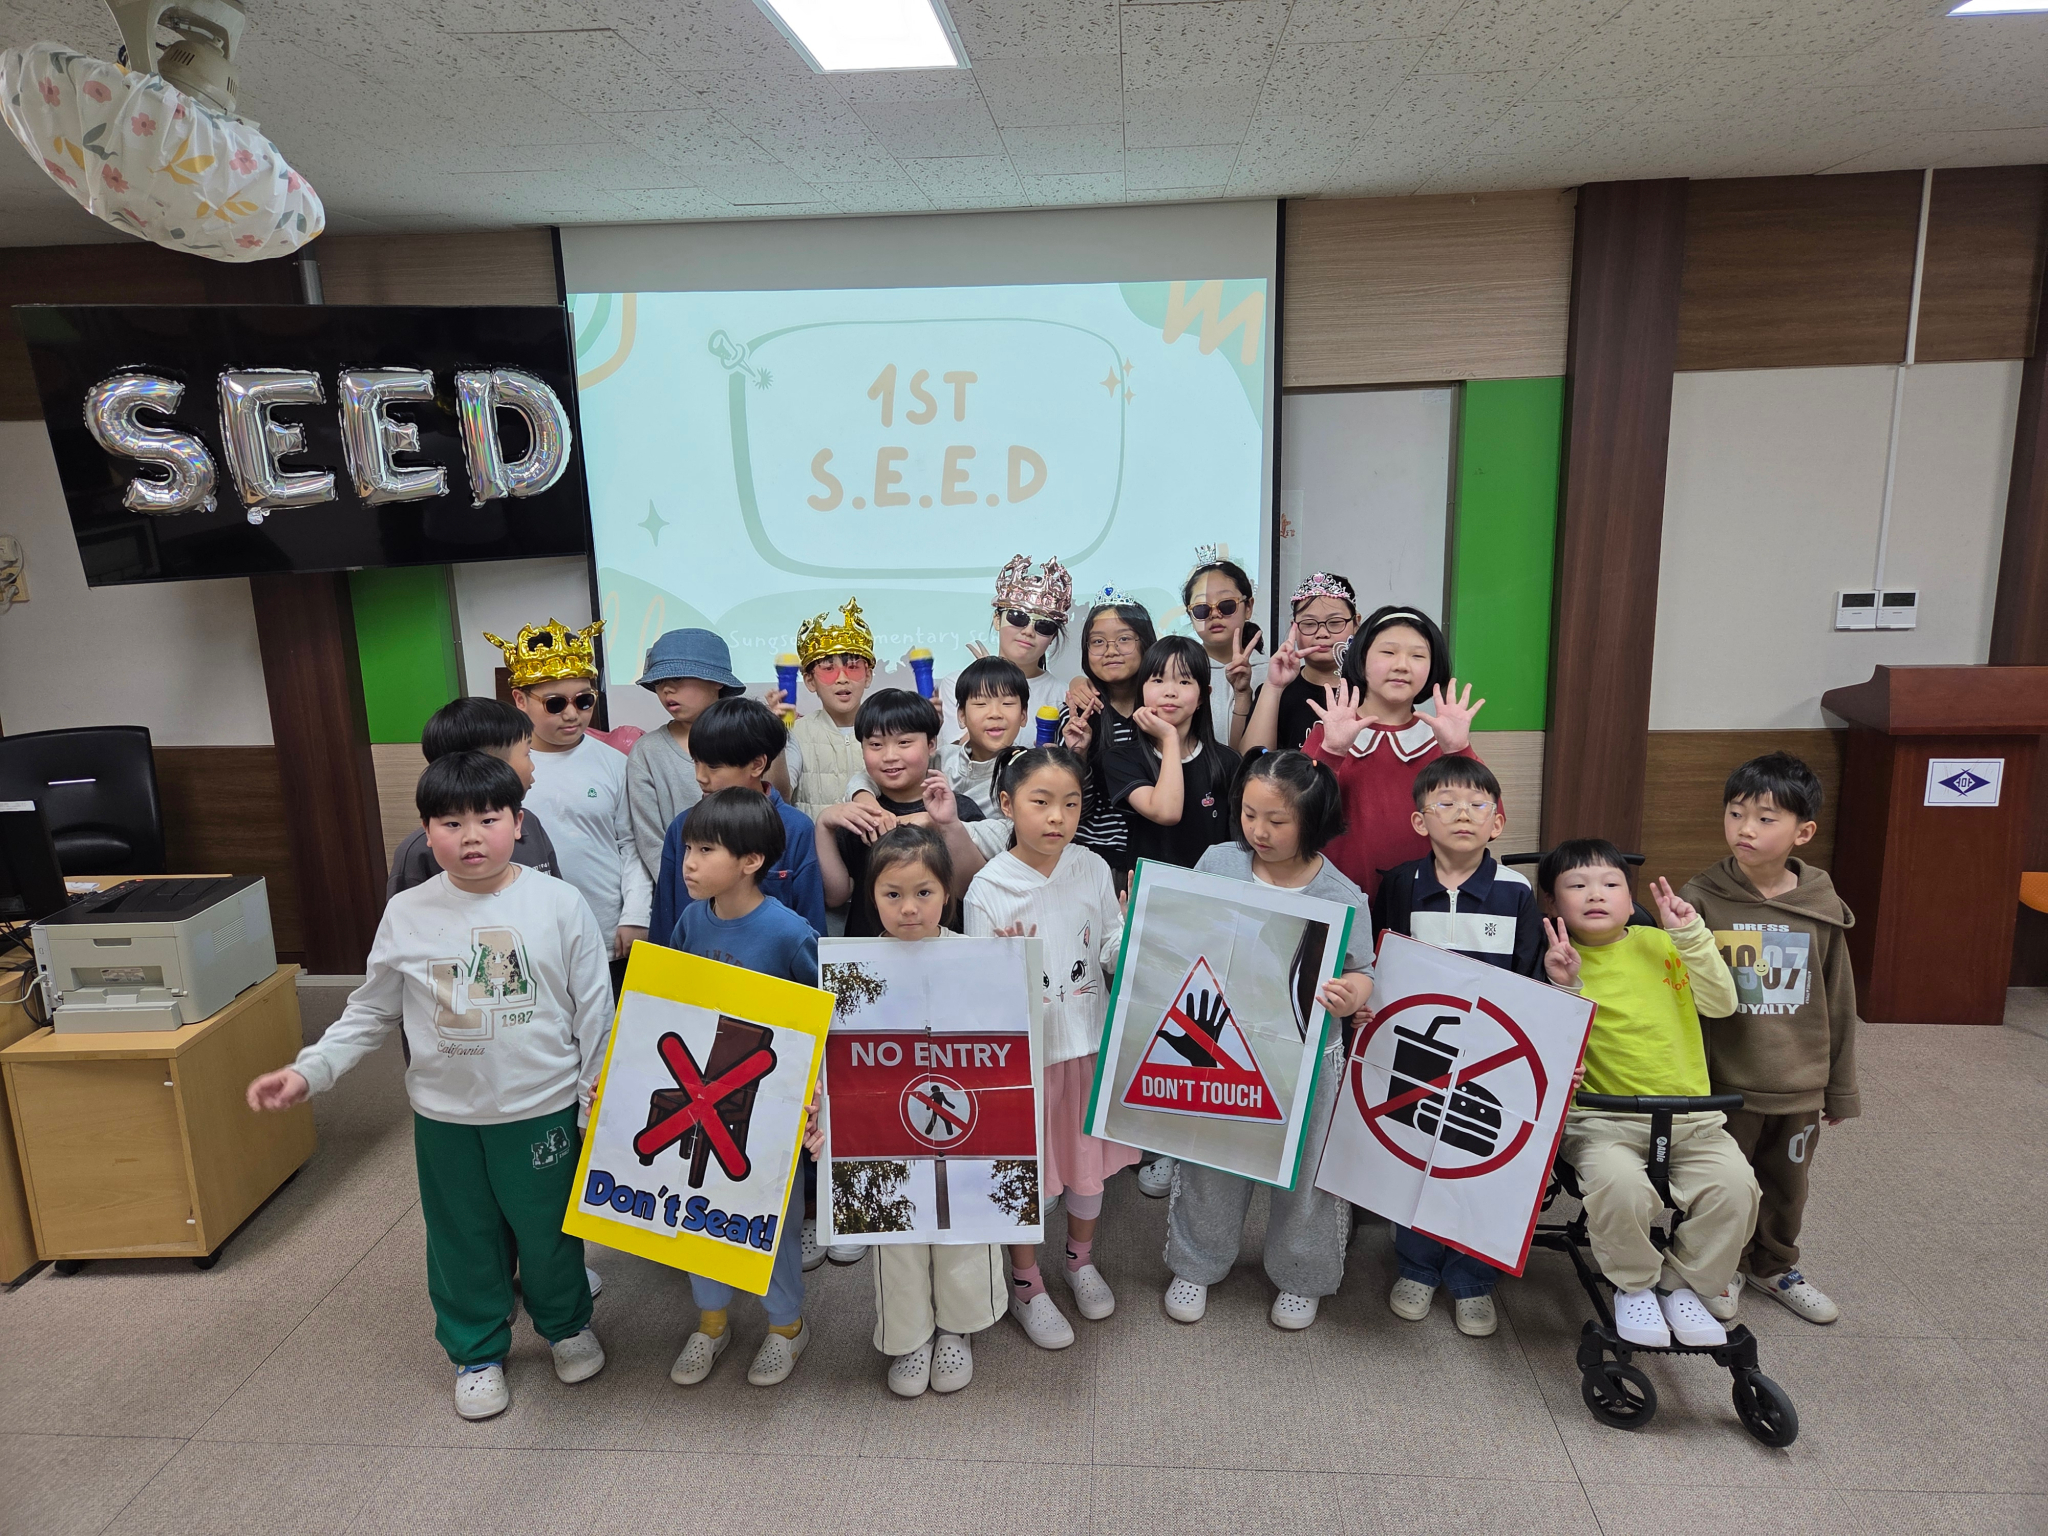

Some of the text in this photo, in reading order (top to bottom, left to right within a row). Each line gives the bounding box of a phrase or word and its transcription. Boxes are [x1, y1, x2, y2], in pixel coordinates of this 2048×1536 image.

[867, 363, 978, 428] 1ST
[83, 365, 573, 524] SEED
[807, 445, 1048, 512] S.E.E.D
[729, 630, 797, 656] Sungso
[874, 627, 960, 651] mentary
[1733, 923, 1790, 932] DRESS
[501, 1010, 533, 1028] 1987
[1737, 1003, 1799, 1015] OYALTY
[437, 1040, 485, 1058] California
[851, 1041, 1011, 1068] NO ENTRY
[1142, 1075, 1262, 1108] DON'T TOUCH
[584, 1169, 778, 1252] Don't Seat!
